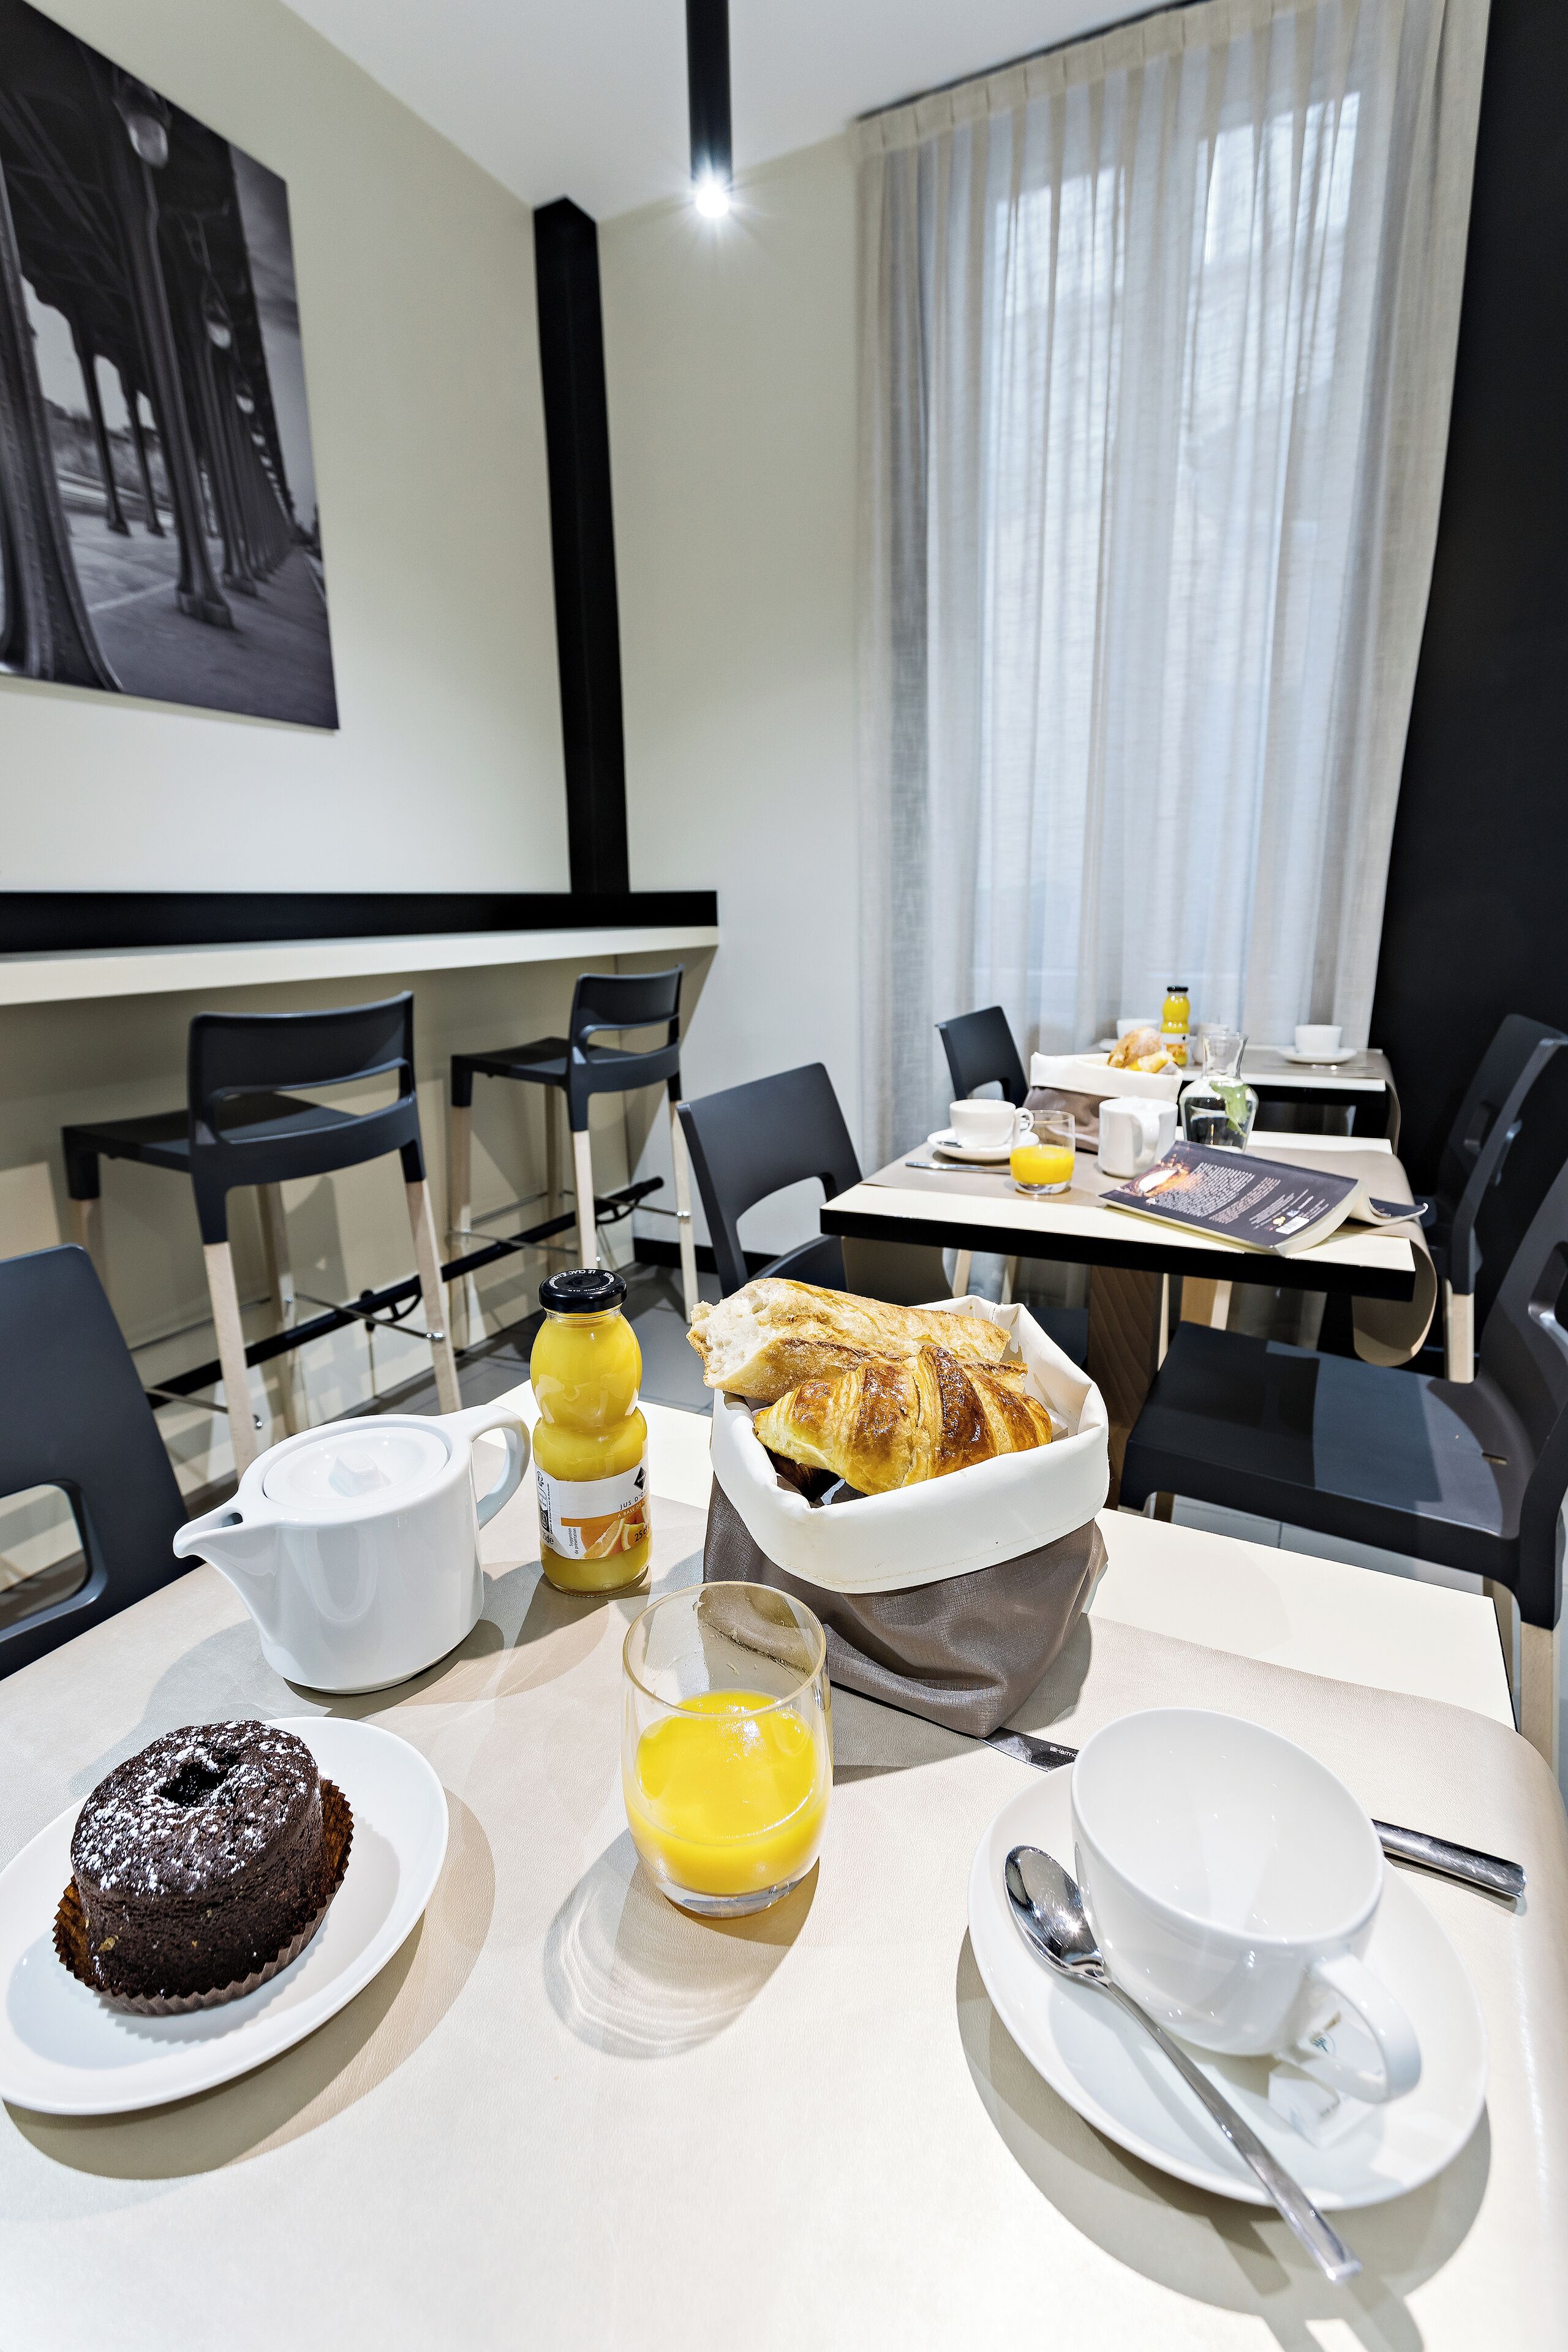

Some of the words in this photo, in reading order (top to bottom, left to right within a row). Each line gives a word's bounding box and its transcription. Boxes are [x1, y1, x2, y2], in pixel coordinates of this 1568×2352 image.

[620, 1500, 631, 1510] JUS
[623, 1507, 635, 1516] BASE
[635, 1529, 643, 1542] 25
